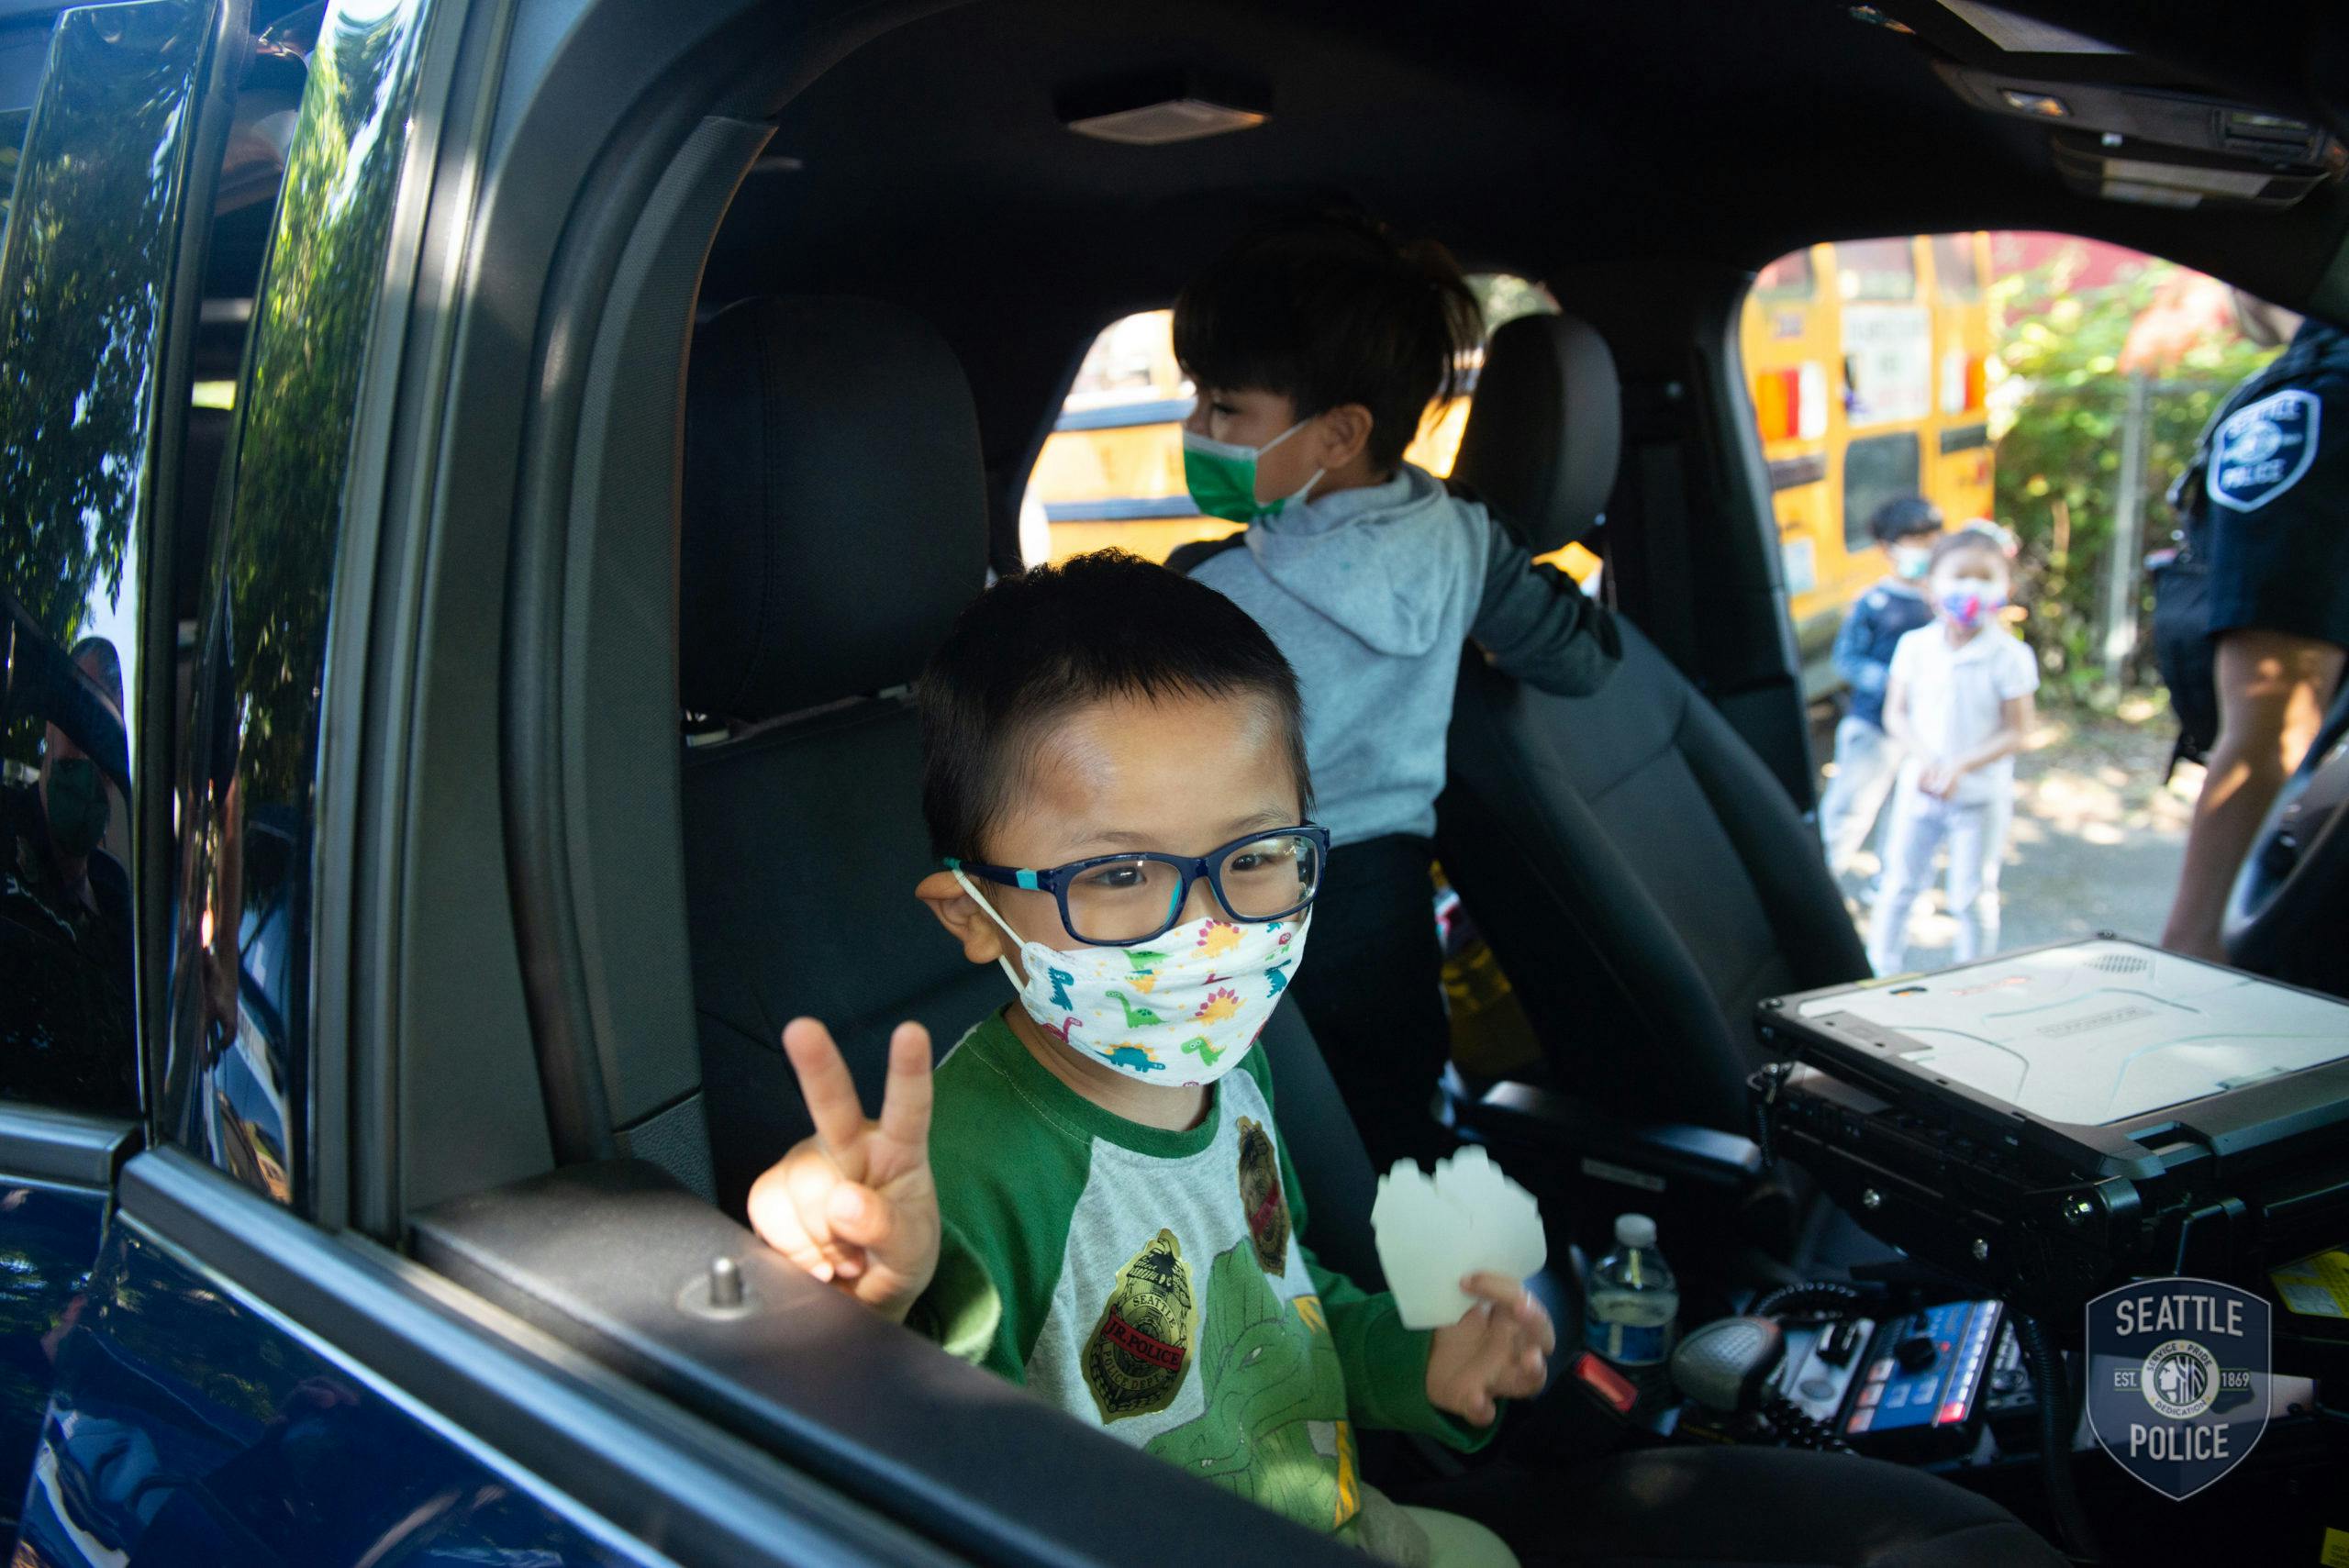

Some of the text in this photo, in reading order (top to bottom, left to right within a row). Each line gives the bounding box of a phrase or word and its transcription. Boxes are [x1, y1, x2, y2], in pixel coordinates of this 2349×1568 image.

[1132, 1296, 1176, 1329] SEATTLE
[1128, 1336, 1179, 1365] POLICE
[1103, 1351, 1128, 1386] POLICE
